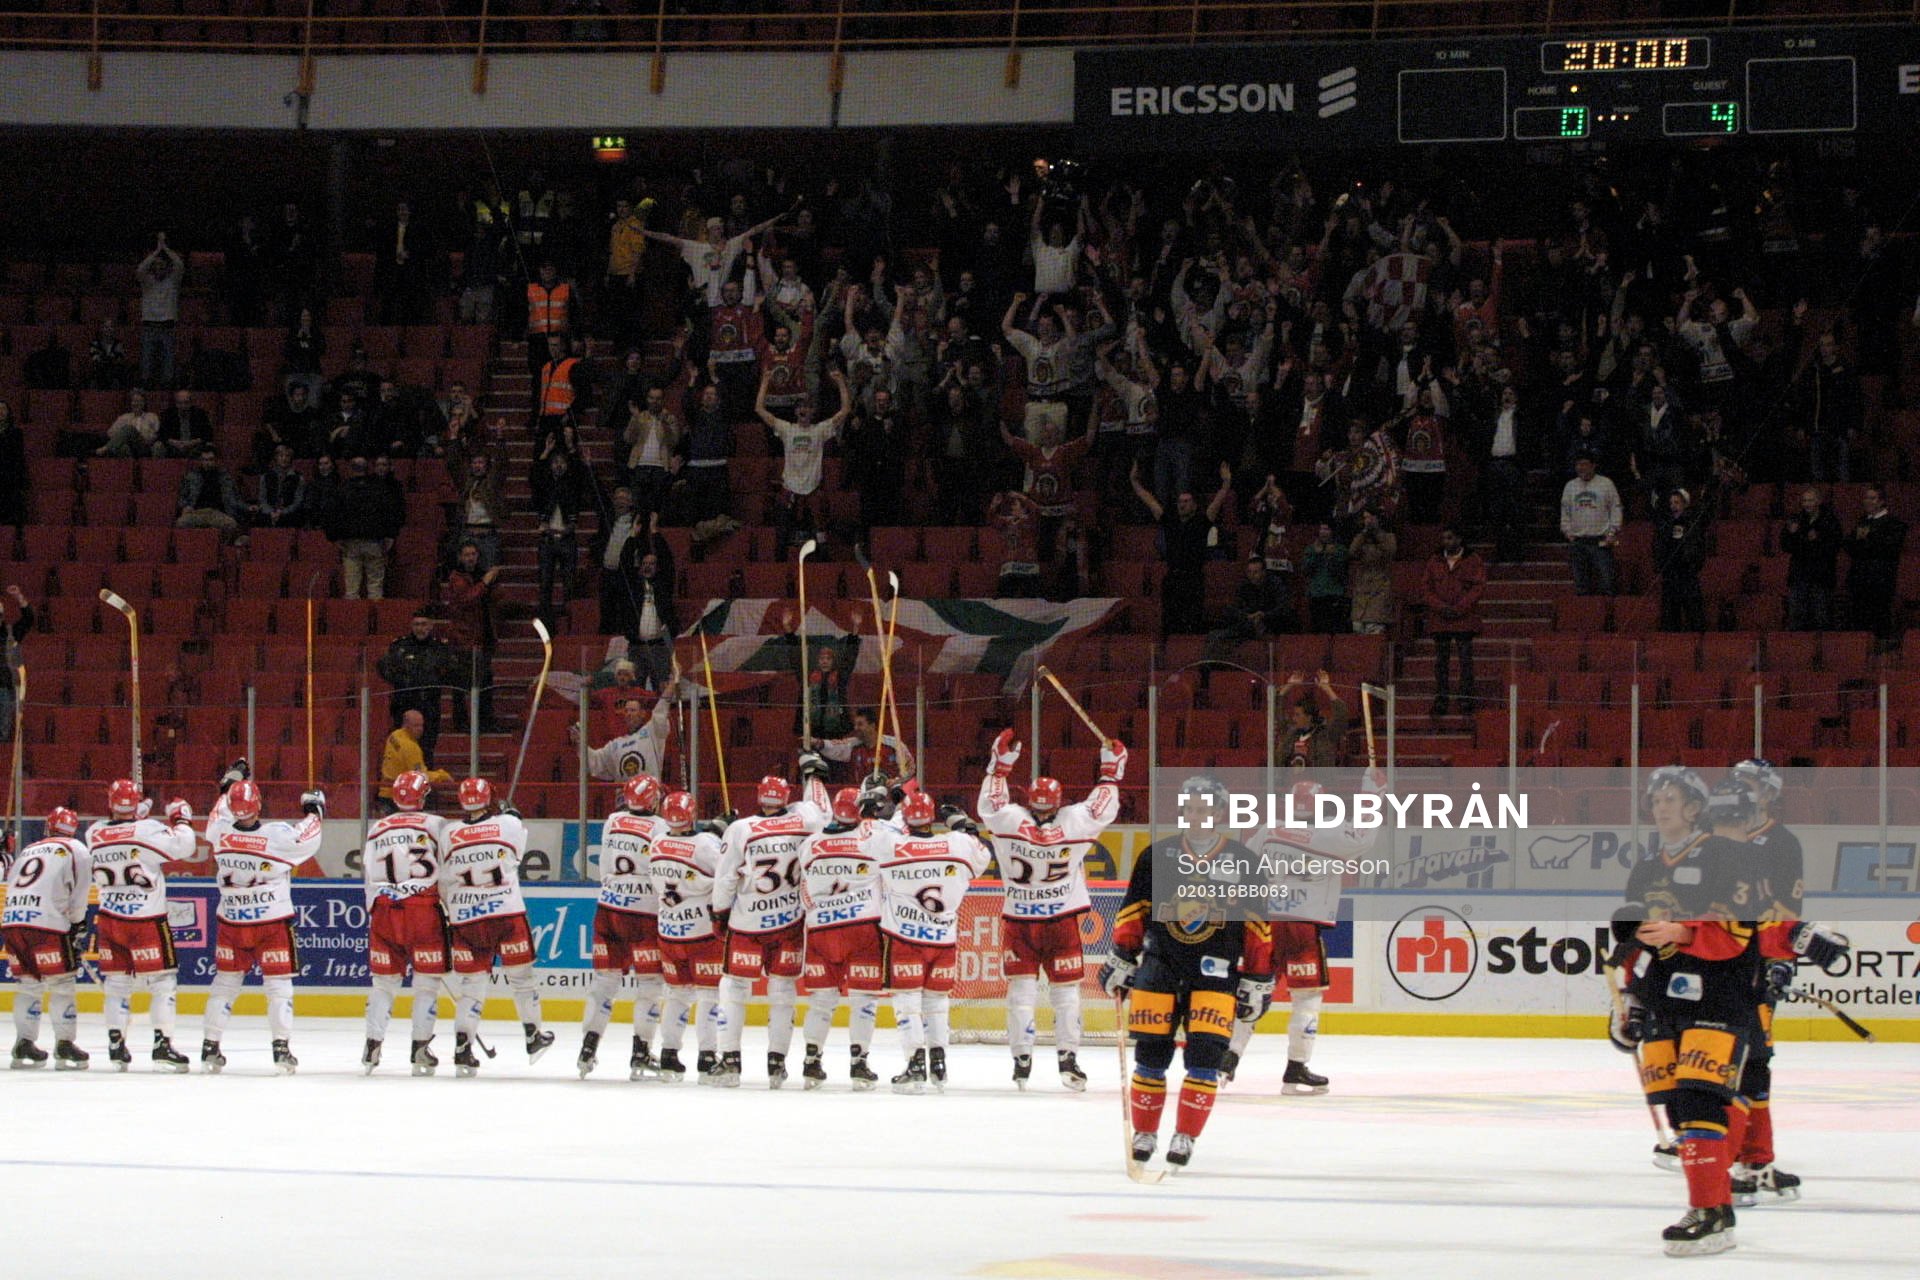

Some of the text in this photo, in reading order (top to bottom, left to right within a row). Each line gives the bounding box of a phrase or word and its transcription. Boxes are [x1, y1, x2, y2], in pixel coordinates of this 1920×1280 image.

[1563, 37, 1688, 71] 20:00
[1111, 83, 1294, 116] ERICSSON
[1561, 107, 1584, 136] 0
[1711, 103, 1735, 132] 4
[374, 834, 414, 850] FALCON
[749, 843, 797, 856] FALCON
[911, 842, 949, 850] KUMHO
[1010, 842, 1056, 859] FALCON
[374, 848, 434, 883] 13
[891, 868, 941, 880] FALCON
[915, 886, 945, 913] 6
[457, 901, 504, 921] SKF
[816, 904, 865, 924] SKF
[1014, 903, 1065, 916] SKF
[899, 923, 948, 941] SKF
[732, 951, 761, 966] PNB
[850, 965, 880, 978] PNB
[893, 963, 924, 977] PNB
[1287, 962, 1317, 976] PNB
[1129, 1011, 1172, 1025] office
[1189, 1007, 1234, 1031] office
[1679, 1050, 1731, 1078] office
